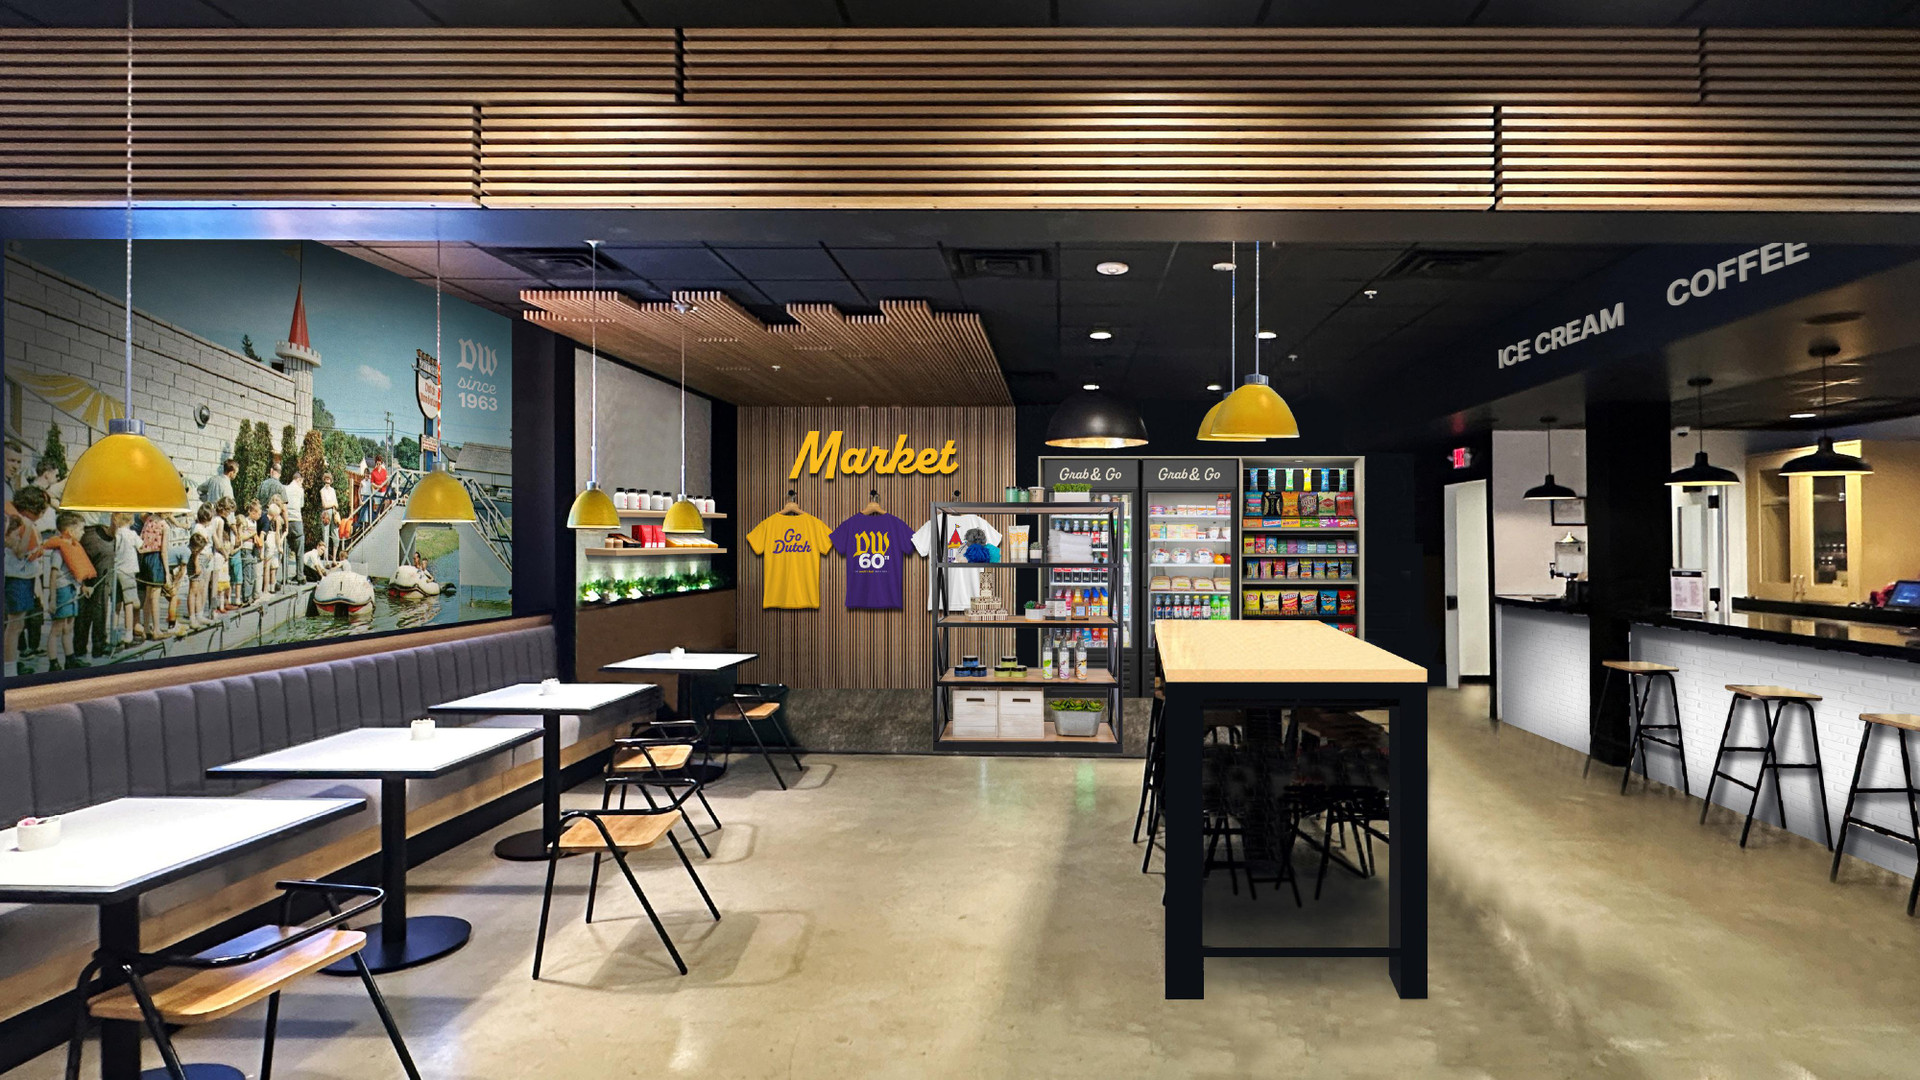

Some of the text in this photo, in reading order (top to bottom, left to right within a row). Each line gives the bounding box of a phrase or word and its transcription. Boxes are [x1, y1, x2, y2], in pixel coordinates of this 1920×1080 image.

[1666, 242, 1810, 306] COFFEE
[1498, 302, 1625, 369] ICE CREAM
[456, 338, 498, 376] DW
[457, 375, 497, 394] since
[458, 392, 498, 411] 1963
[789, 431, 959, 480] Market
[1059, 467, 1122, 481] Grab & Go
[1158, 467, 1221, 481] Grab & Go
[784, 528, 802, 542] Go
[853, 530, 890, 558] DW
[772, 539, 812, 554] Dutch
